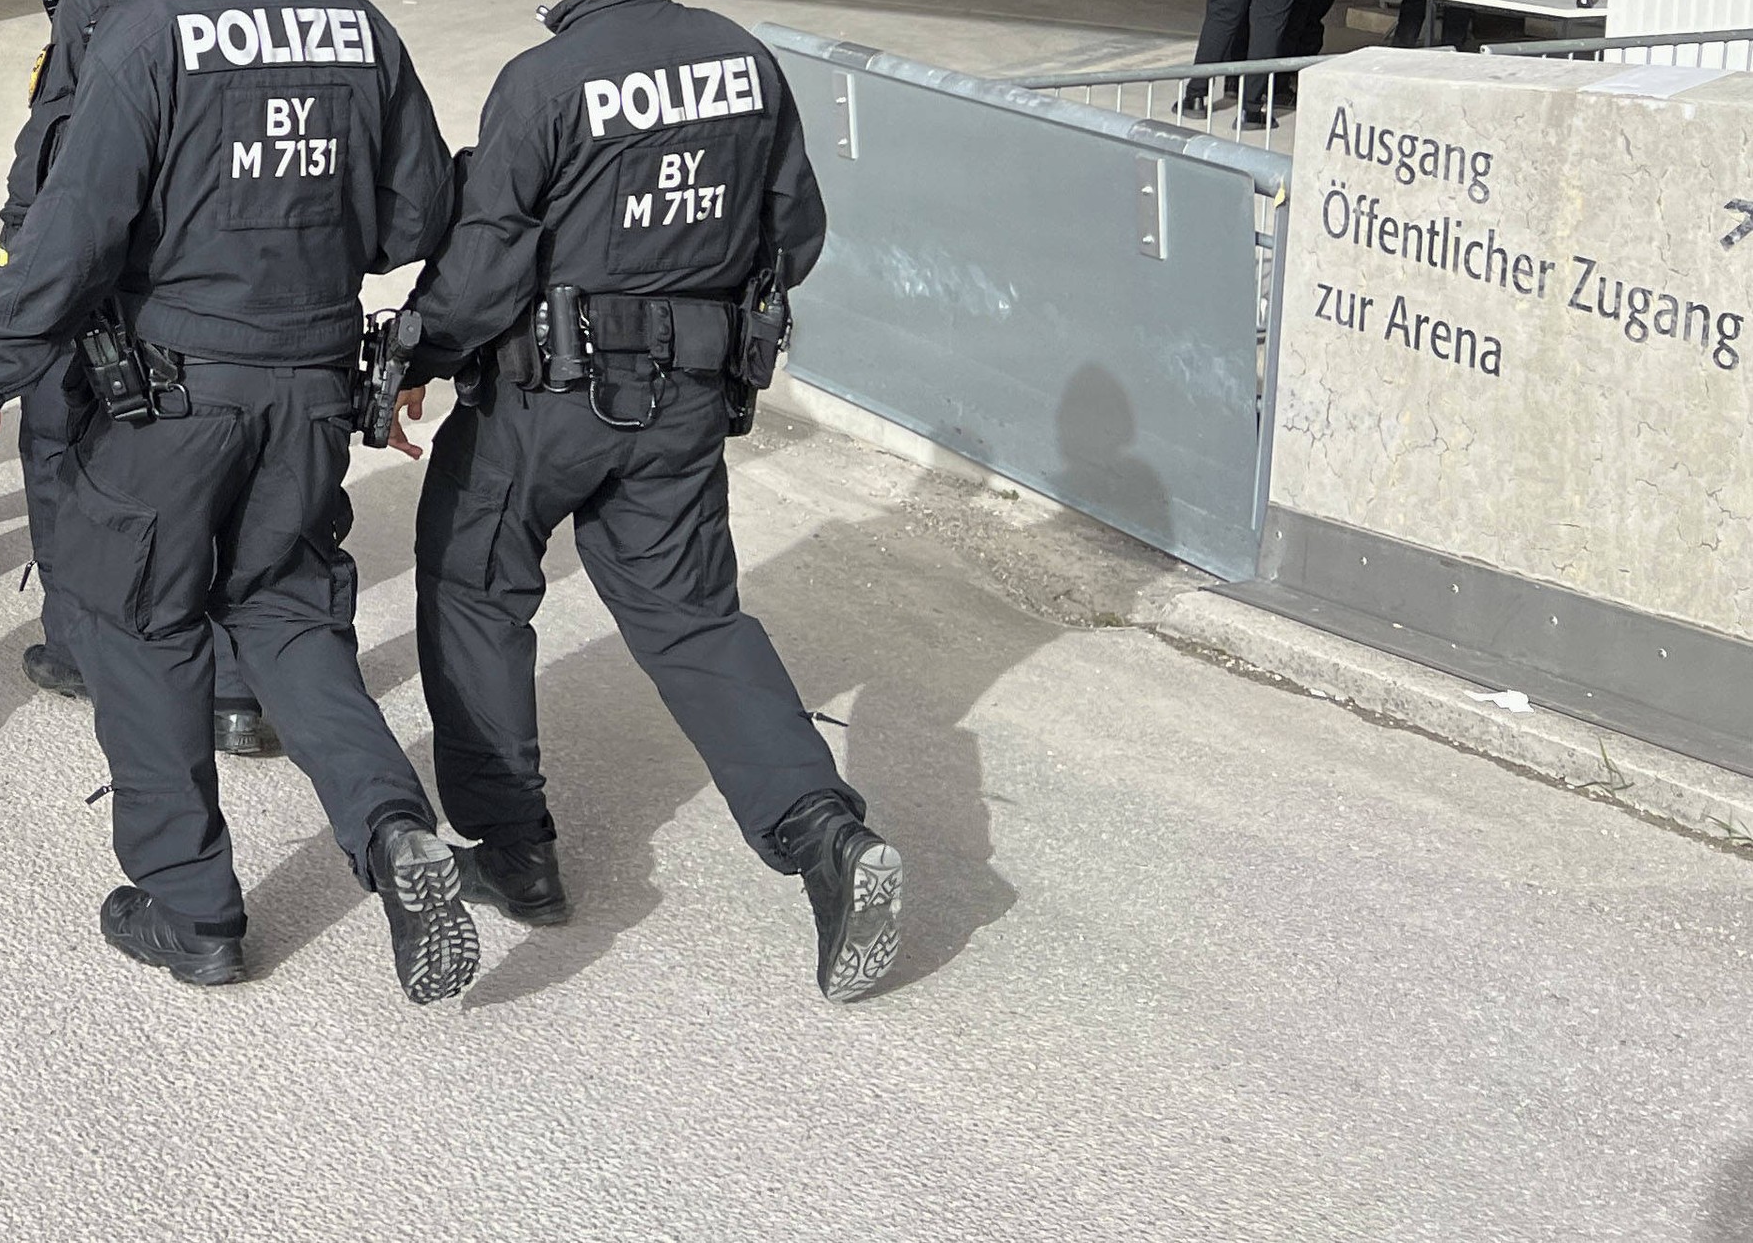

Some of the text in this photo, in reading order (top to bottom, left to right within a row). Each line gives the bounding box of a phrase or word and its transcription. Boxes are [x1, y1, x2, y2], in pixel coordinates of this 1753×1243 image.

[176, 7, 375, 71] POLIZEI
[266, 97, 316, 137] BY
[584, 56, 763, 137] POLIZEI
[232, 138, 337, 179] M 7131
[658, 149, 705, 189] BY
[1325, 104, 1494, 205] Ausgang
[623, 184, 726, 229] M 7131
[1322, 179, 1745, 371] Öffentlicher Zugang
[1315, 282, 1504, 378] zur Arena
